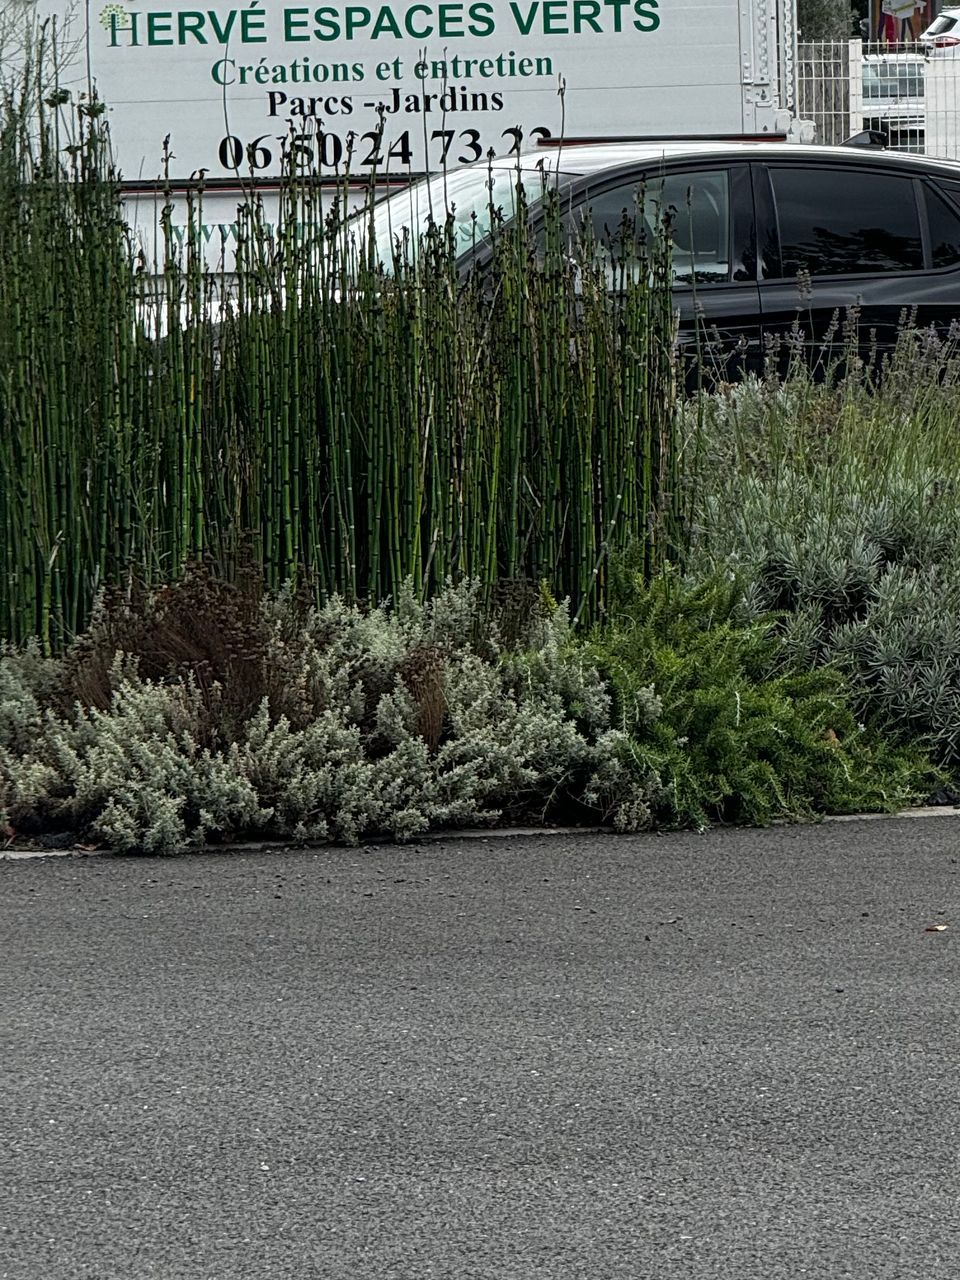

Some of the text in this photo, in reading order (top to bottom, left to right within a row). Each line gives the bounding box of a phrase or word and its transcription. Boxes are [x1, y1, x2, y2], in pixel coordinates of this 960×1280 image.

[103, 1, 267, 47] HERVÉ
[283, 2, 495, 42] ESPACES
[211, 51, 553, 86] Créations et entretien
[266, 90, 353, 116] Parcs
[386, 86, 504, 114] Jardins
[218, 134, 272, 170] 06
[292, 132, 342, 167] 50
[360, 130, 413, 165] 24
[431, 128, 483, 164] 73
